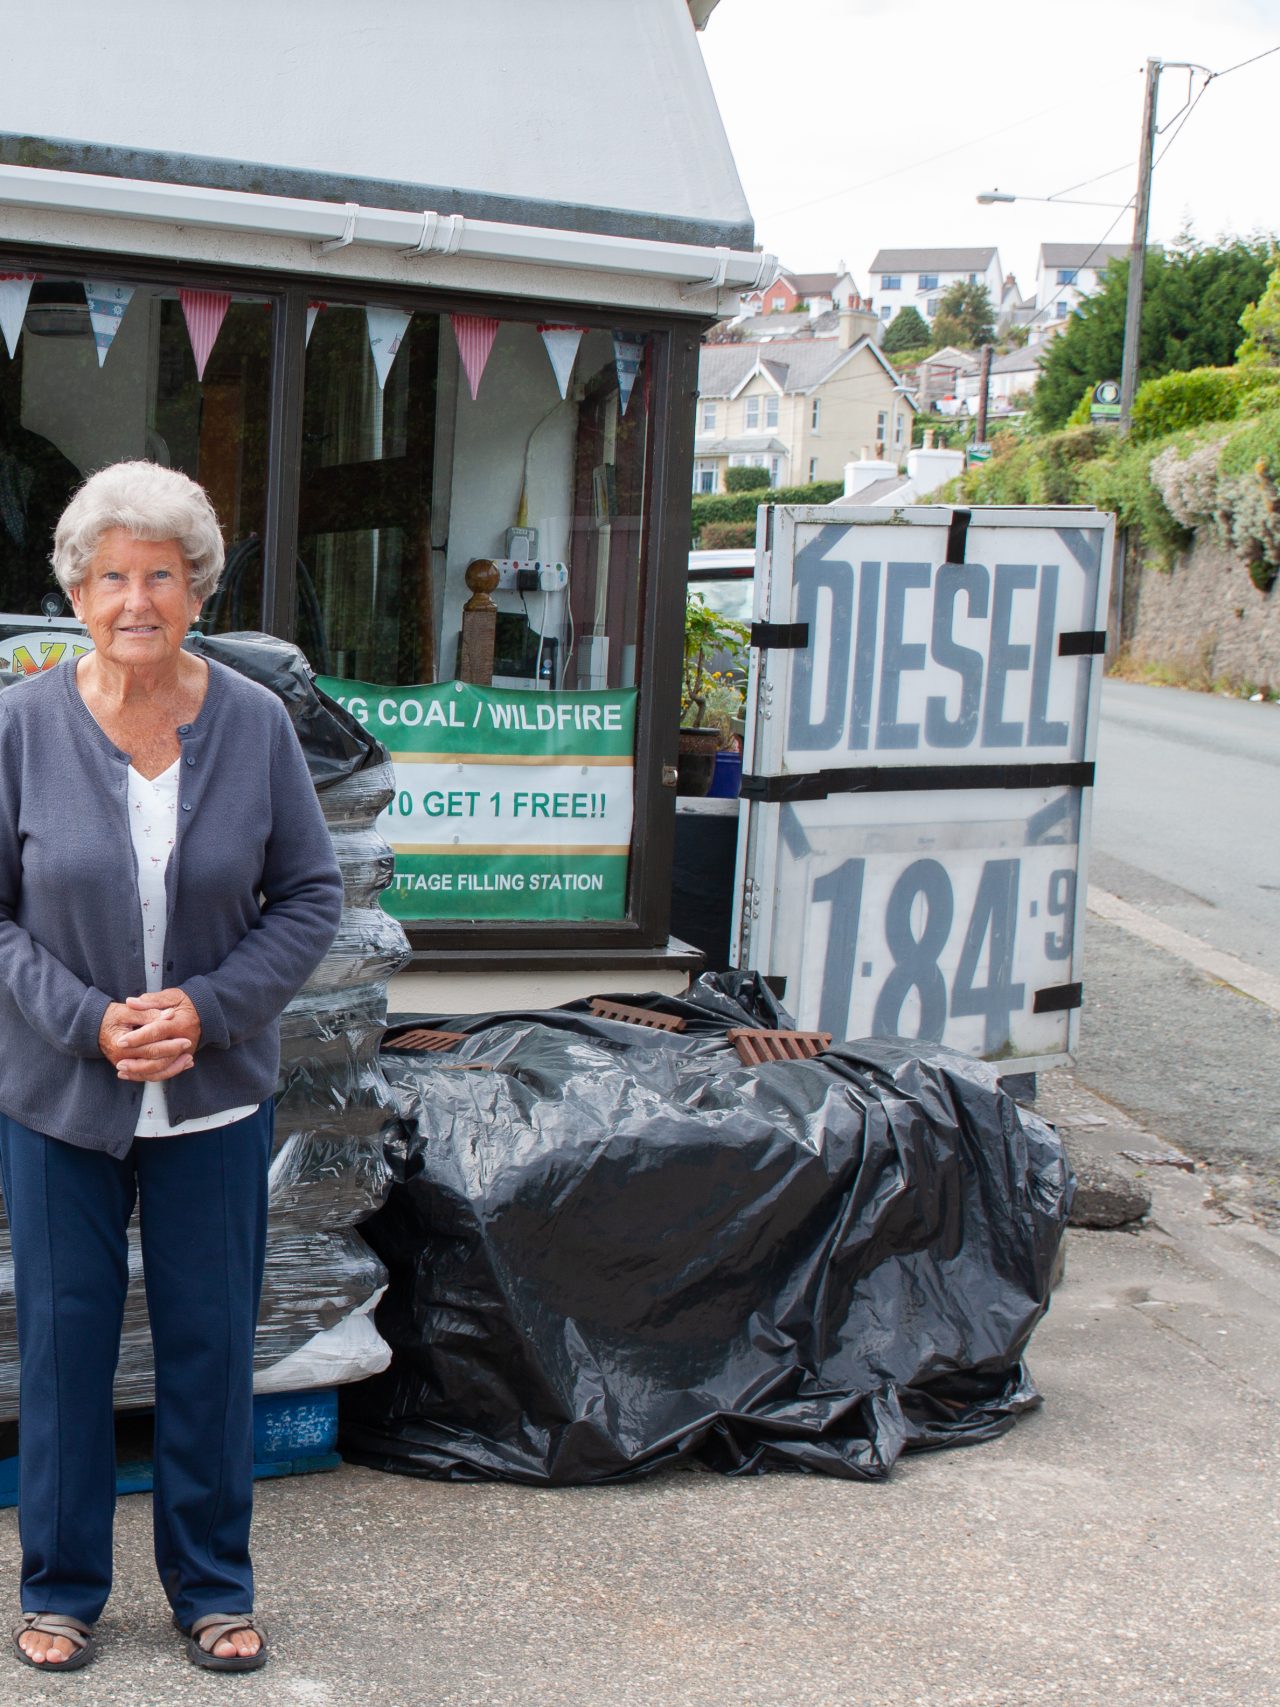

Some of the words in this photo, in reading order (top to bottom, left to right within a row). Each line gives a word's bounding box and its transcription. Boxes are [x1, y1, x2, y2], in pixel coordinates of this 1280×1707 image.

[787, 560, 1070, 751] DIESEL
[378, 699, 466, 728] COAL
[472, 701, 483, 729] /
[487, 703, 623, 731] WILDFIRE
[422, 790, 481, 818] GET
[490, 791, 500, 817] 1
[513, 792, 607, 818] FREE!!
[387, 873, 453, 891] TTAGE
[457, 873, 525, 891] FILLING
[528, 873, 604, 891] STATION
